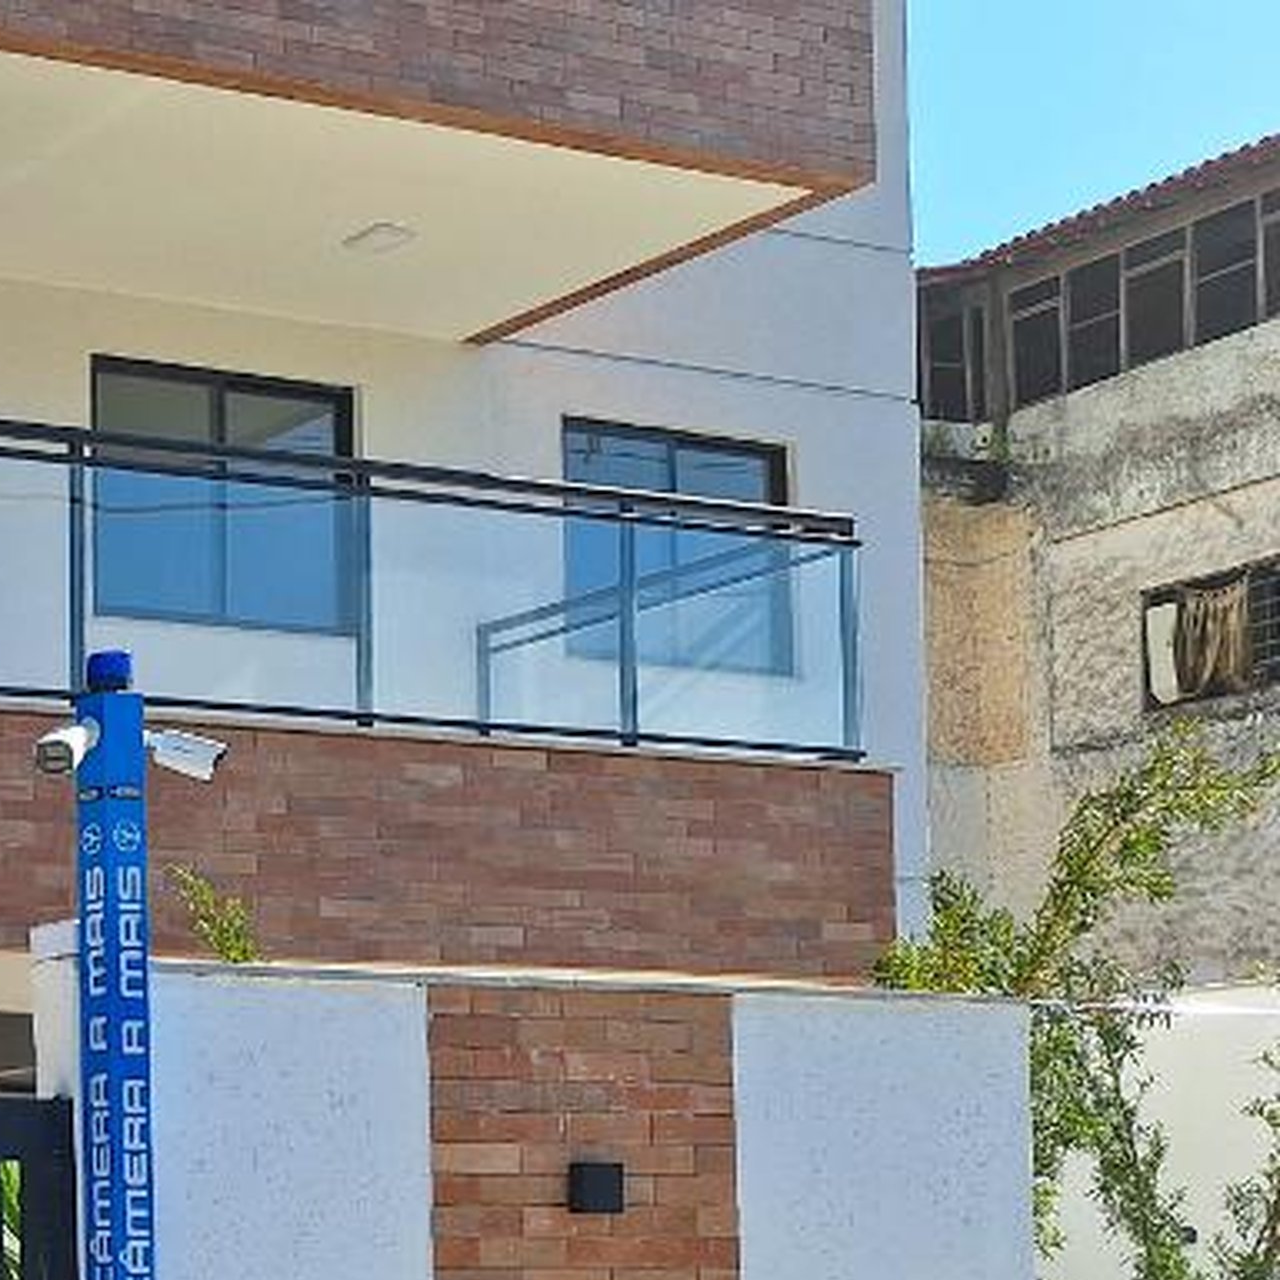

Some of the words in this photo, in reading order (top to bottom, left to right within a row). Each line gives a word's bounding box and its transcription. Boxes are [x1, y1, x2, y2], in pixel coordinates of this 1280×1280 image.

[85, 866, 106, 996] MAIS
[118, 866, 145, 998] MAIS
[88, 1017, 108, 1051] A
[121, 1019, 148, 1055] A
